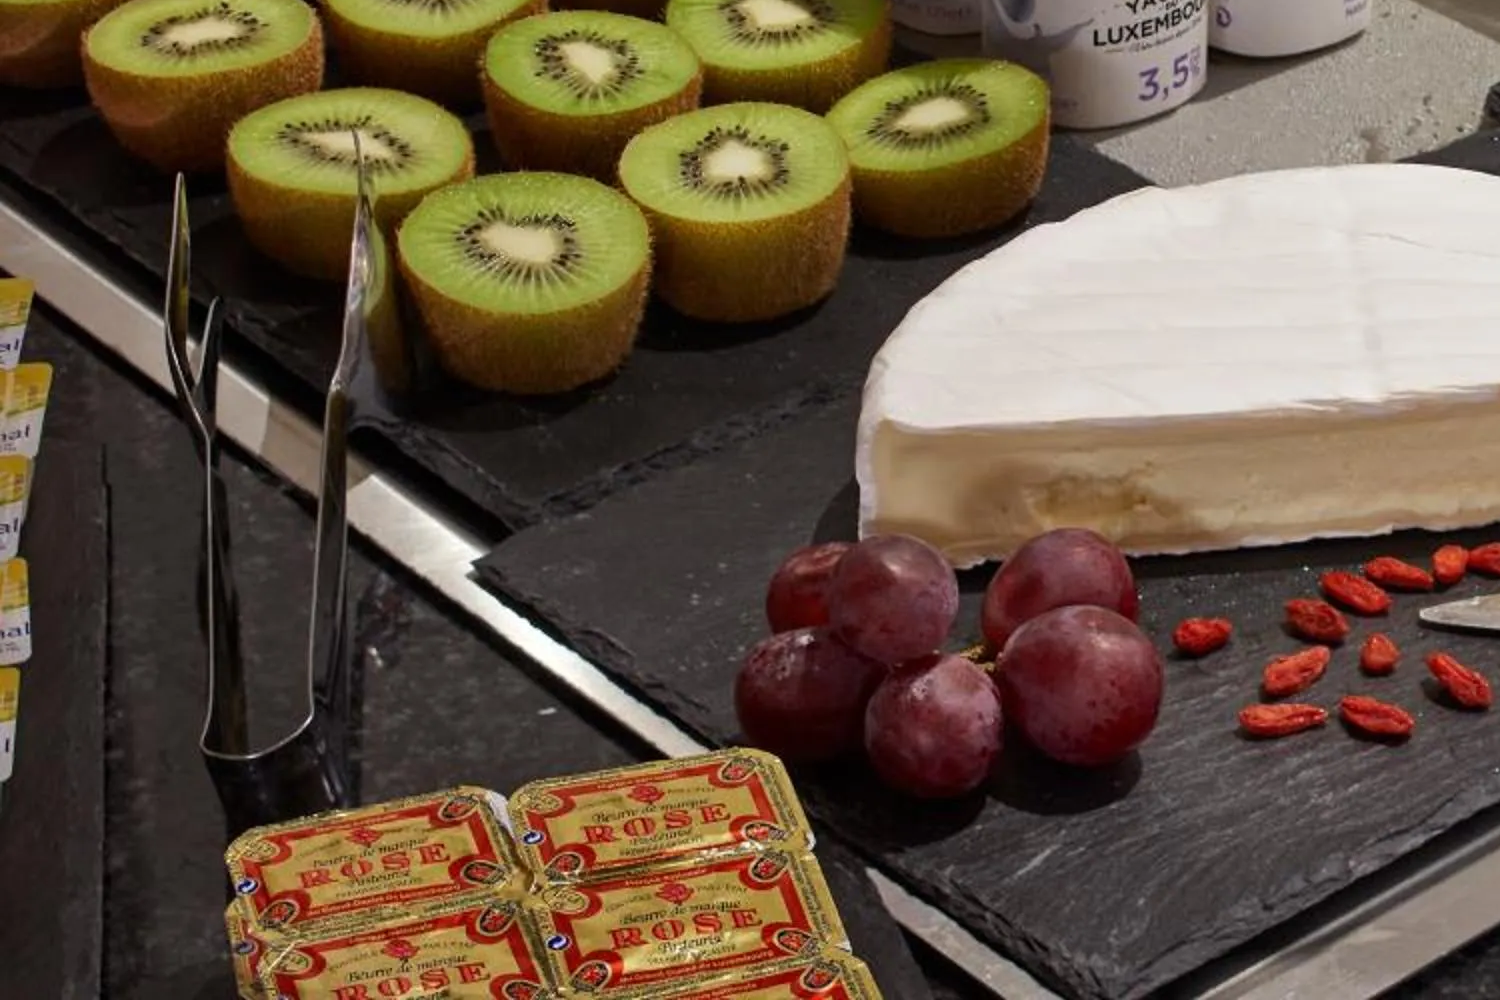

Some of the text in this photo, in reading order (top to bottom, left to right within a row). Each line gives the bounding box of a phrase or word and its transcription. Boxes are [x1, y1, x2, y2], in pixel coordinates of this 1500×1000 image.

[1138, 52, 1190, 102] 3,5
[580, 802, 732, 845] ROSE
[296, 843, 451, 889] ROSE
[608, 908, 764, 951] ROSE
[619, 909, 670, 926] Beurre
[688, 898, 742, 917] marque
[329, 961, 492, 1000] ROSE
